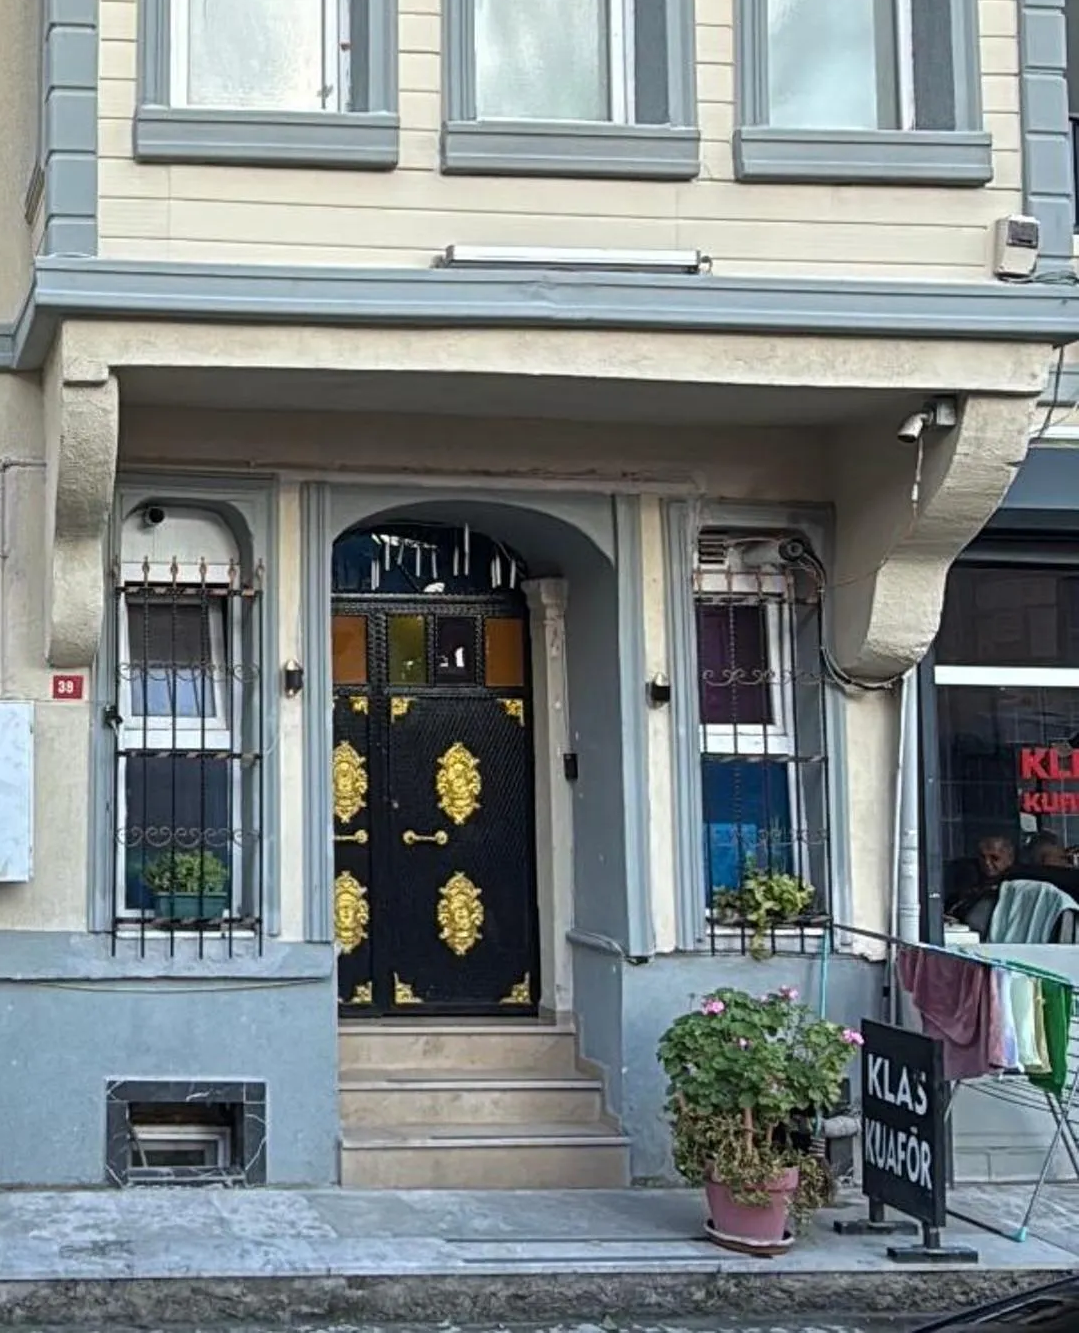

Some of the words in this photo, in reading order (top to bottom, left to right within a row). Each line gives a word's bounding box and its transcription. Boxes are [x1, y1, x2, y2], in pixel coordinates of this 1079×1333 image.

[58, 680, 74, 694] 39
[867, 1053, 928, 1116] KLAS
[864, 1117, 933, 1190] KUAFÖR
